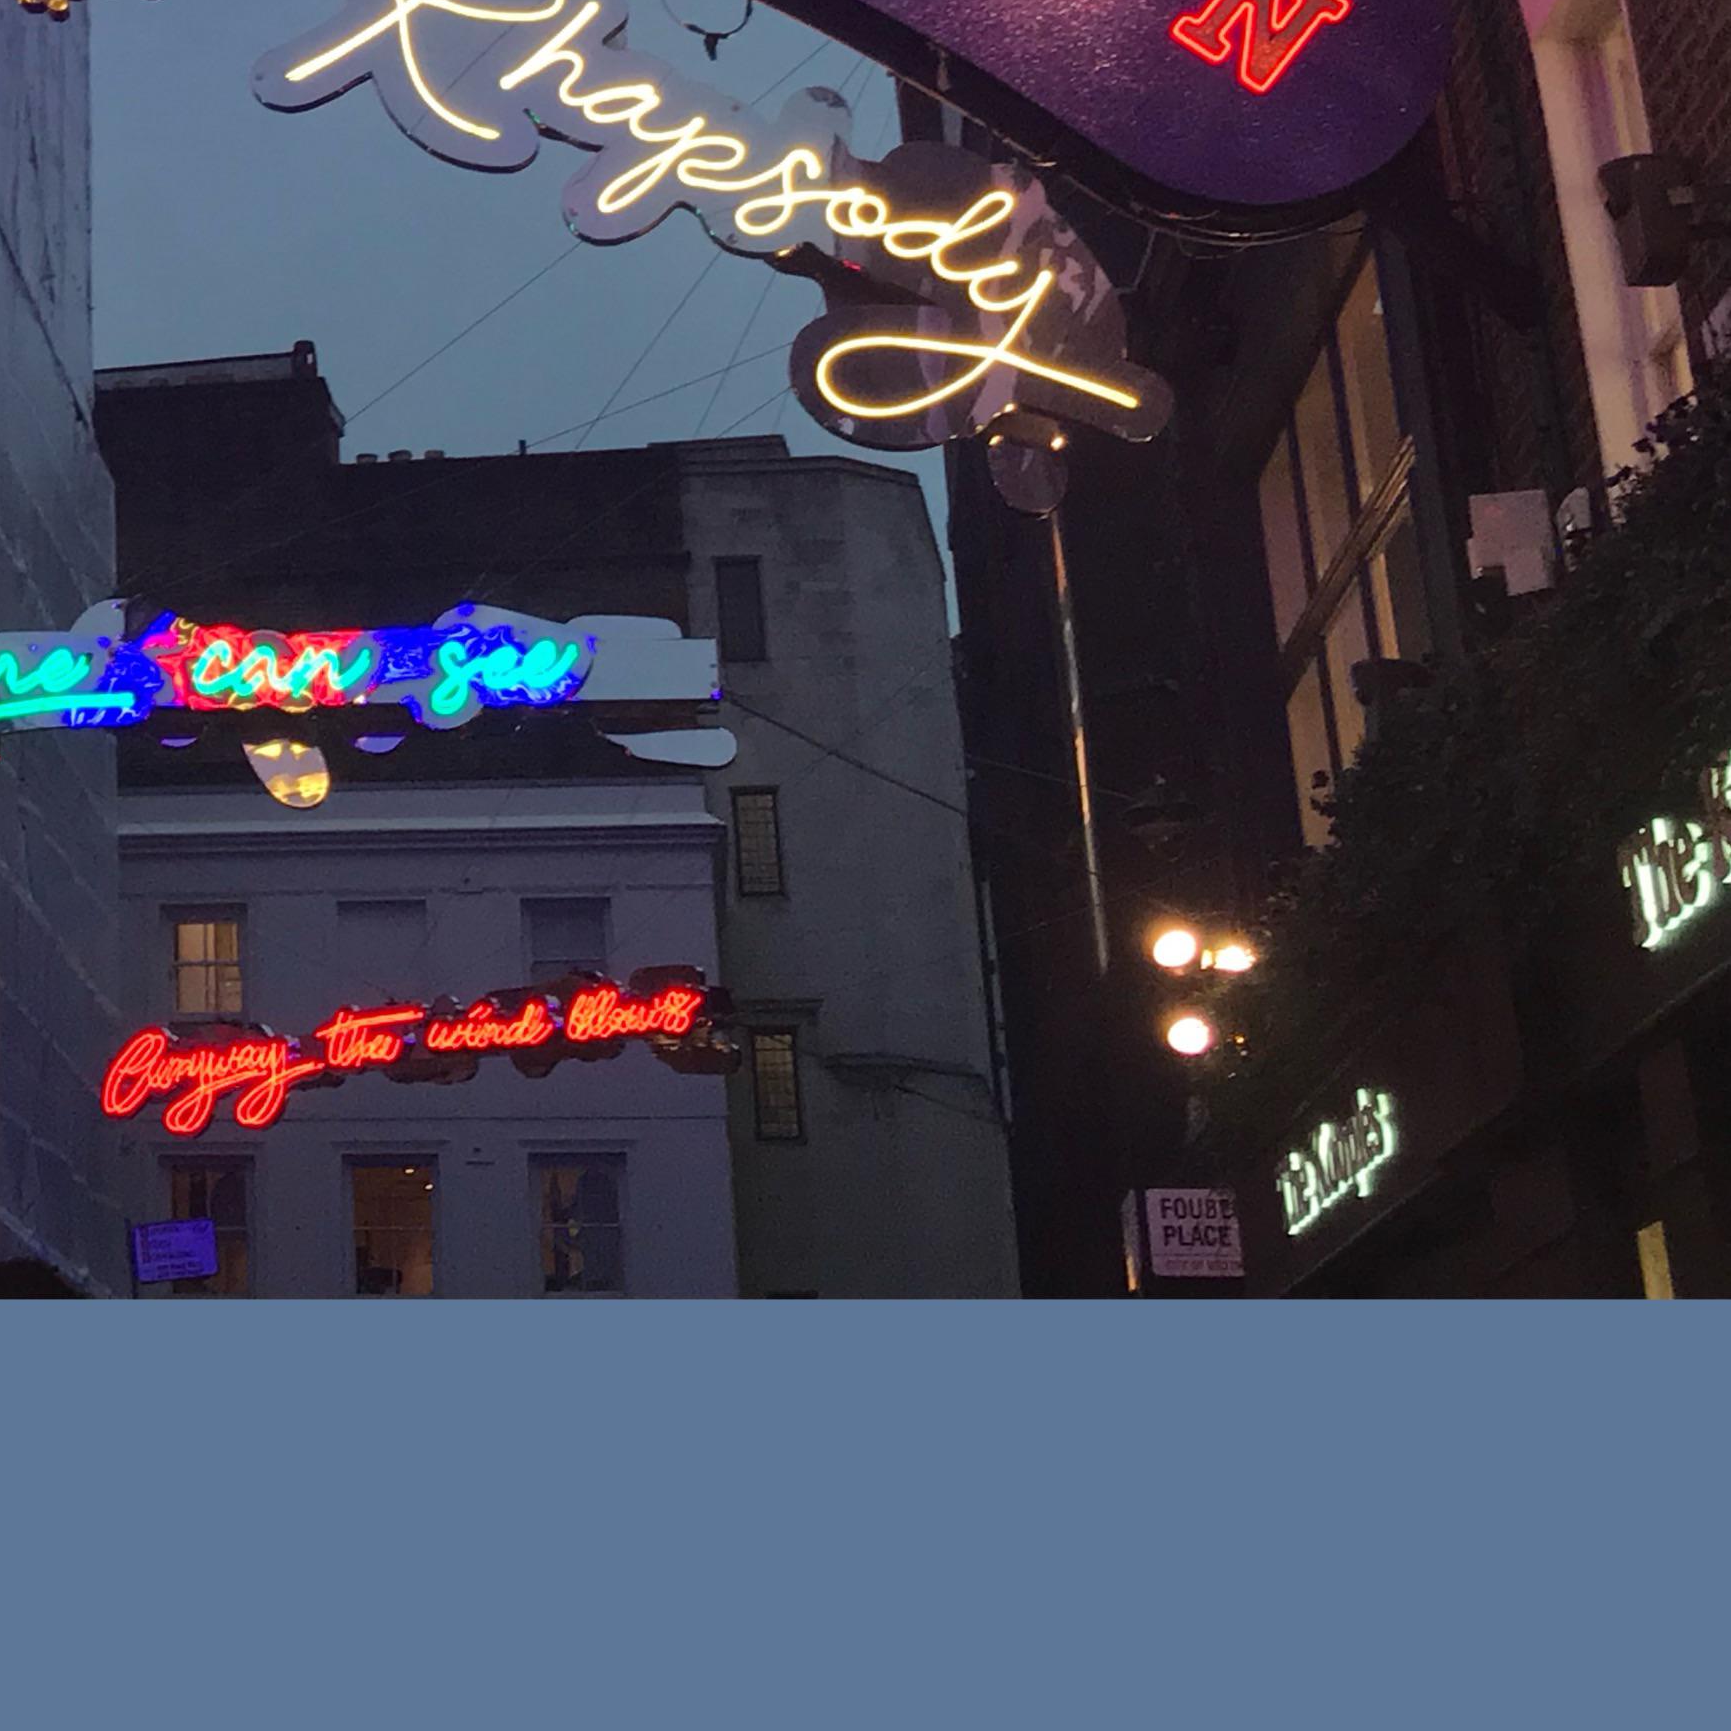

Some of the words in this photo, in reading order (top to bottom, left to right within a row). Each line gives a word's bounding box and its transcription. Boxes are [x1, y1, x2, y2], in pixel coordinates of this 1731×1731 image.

[191, 638, 371, 697] can
[429, 638, 580, 717] see
[314, 1009, 425, 1069] the
[425, 996, 555, 1050] wind
[1159, 1197, 1235, 1220] FOUBE
[1163, 1224, 1232, 1247] PLACE
